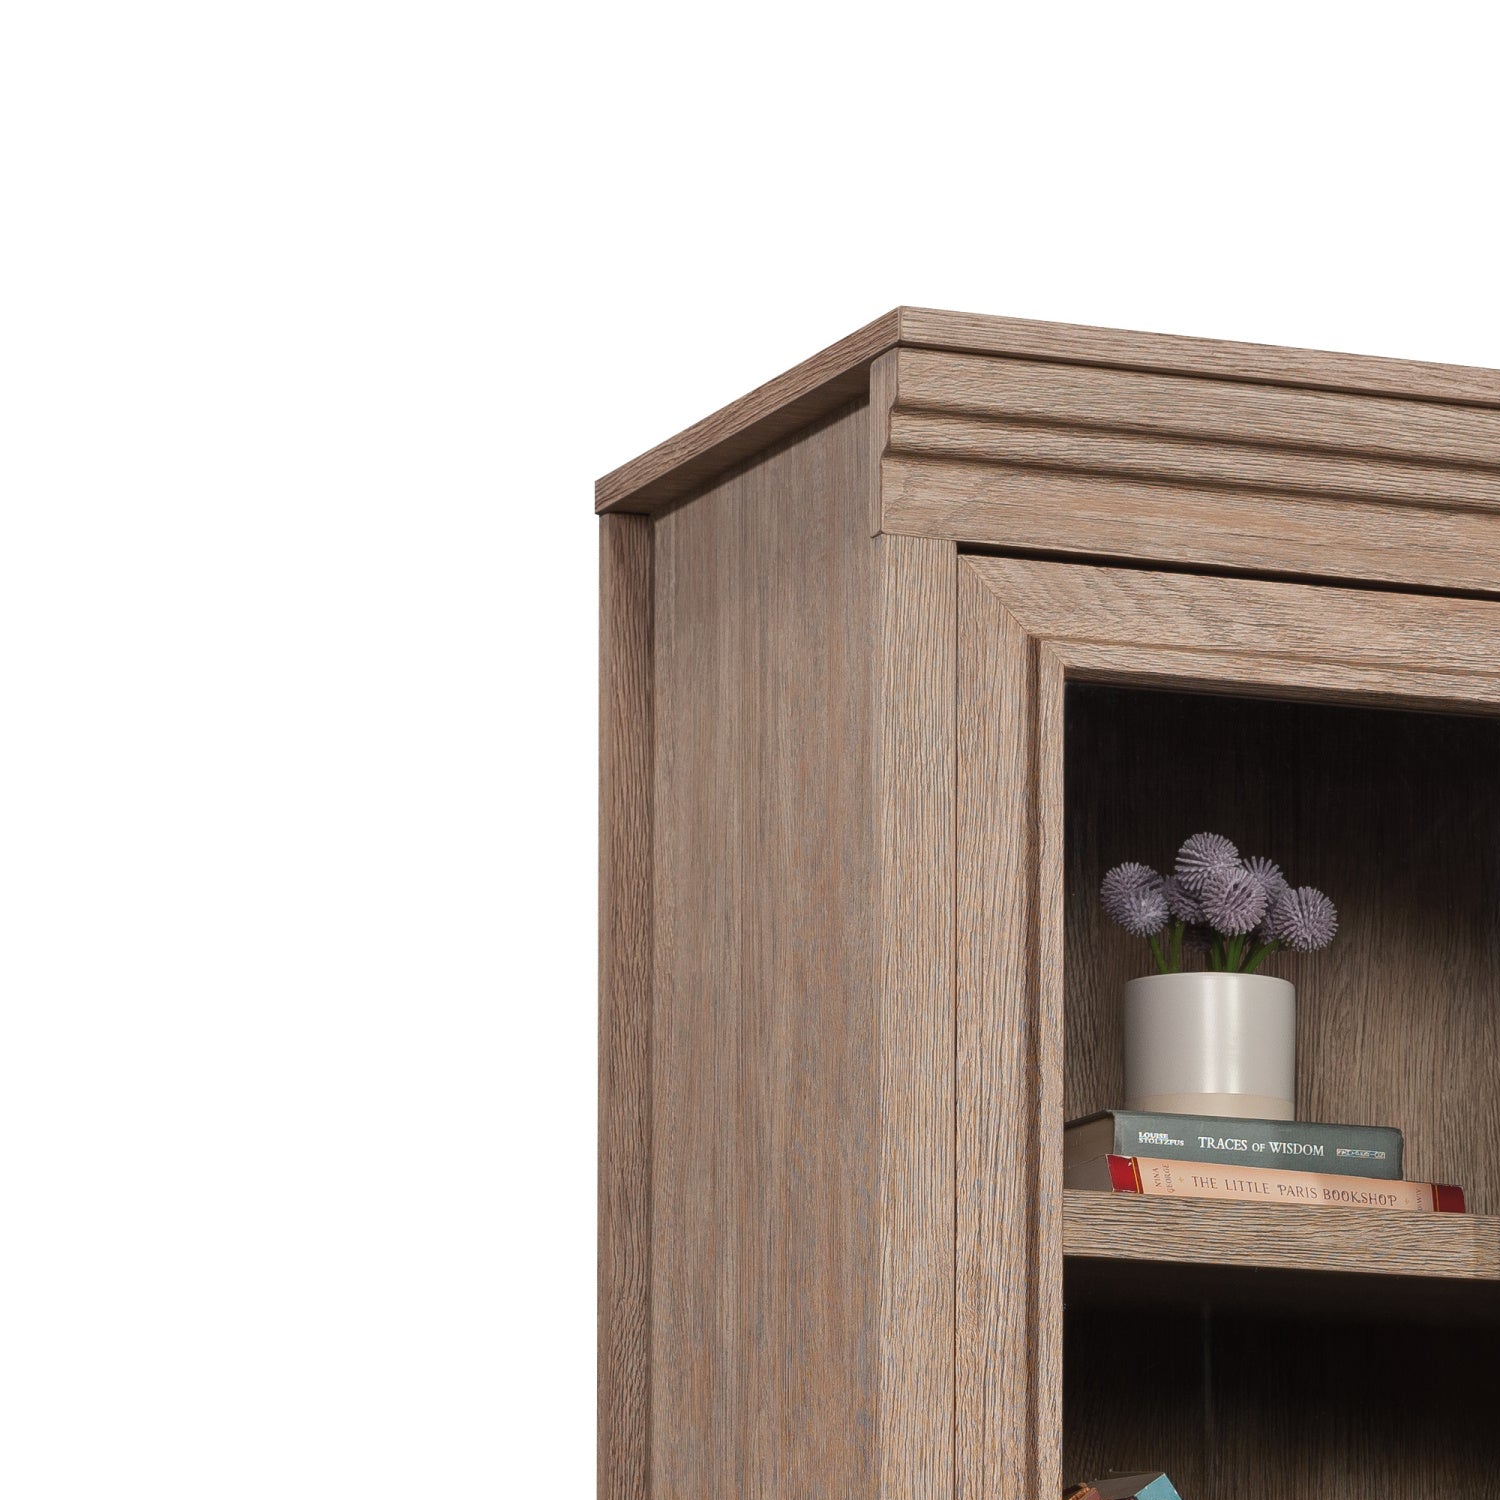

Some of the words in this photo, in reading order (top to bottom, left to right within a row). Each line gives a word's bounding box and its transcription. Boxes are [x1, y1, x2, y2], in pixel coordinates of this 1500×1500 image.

[1138, 1131, 1169, 1140] LOUISE
[1197, 1136, 1248, 1151] TRACES
[1252, 1142, 1266, 1153] OF
[1268, 1141, 1325, 1157] WISDOM
[1152, 1167, 1162, 1188] NINA
[1162, 1163, 1175, 1193] GEORGE
[1191, 1175, 1218, 1190] THE
[1224, 1178, 1271, 1194] LITTLE
[1276, 1184, 1318, 1199] PARIS
[1322, 1188, 1397, 1206] BOOKSHOP
